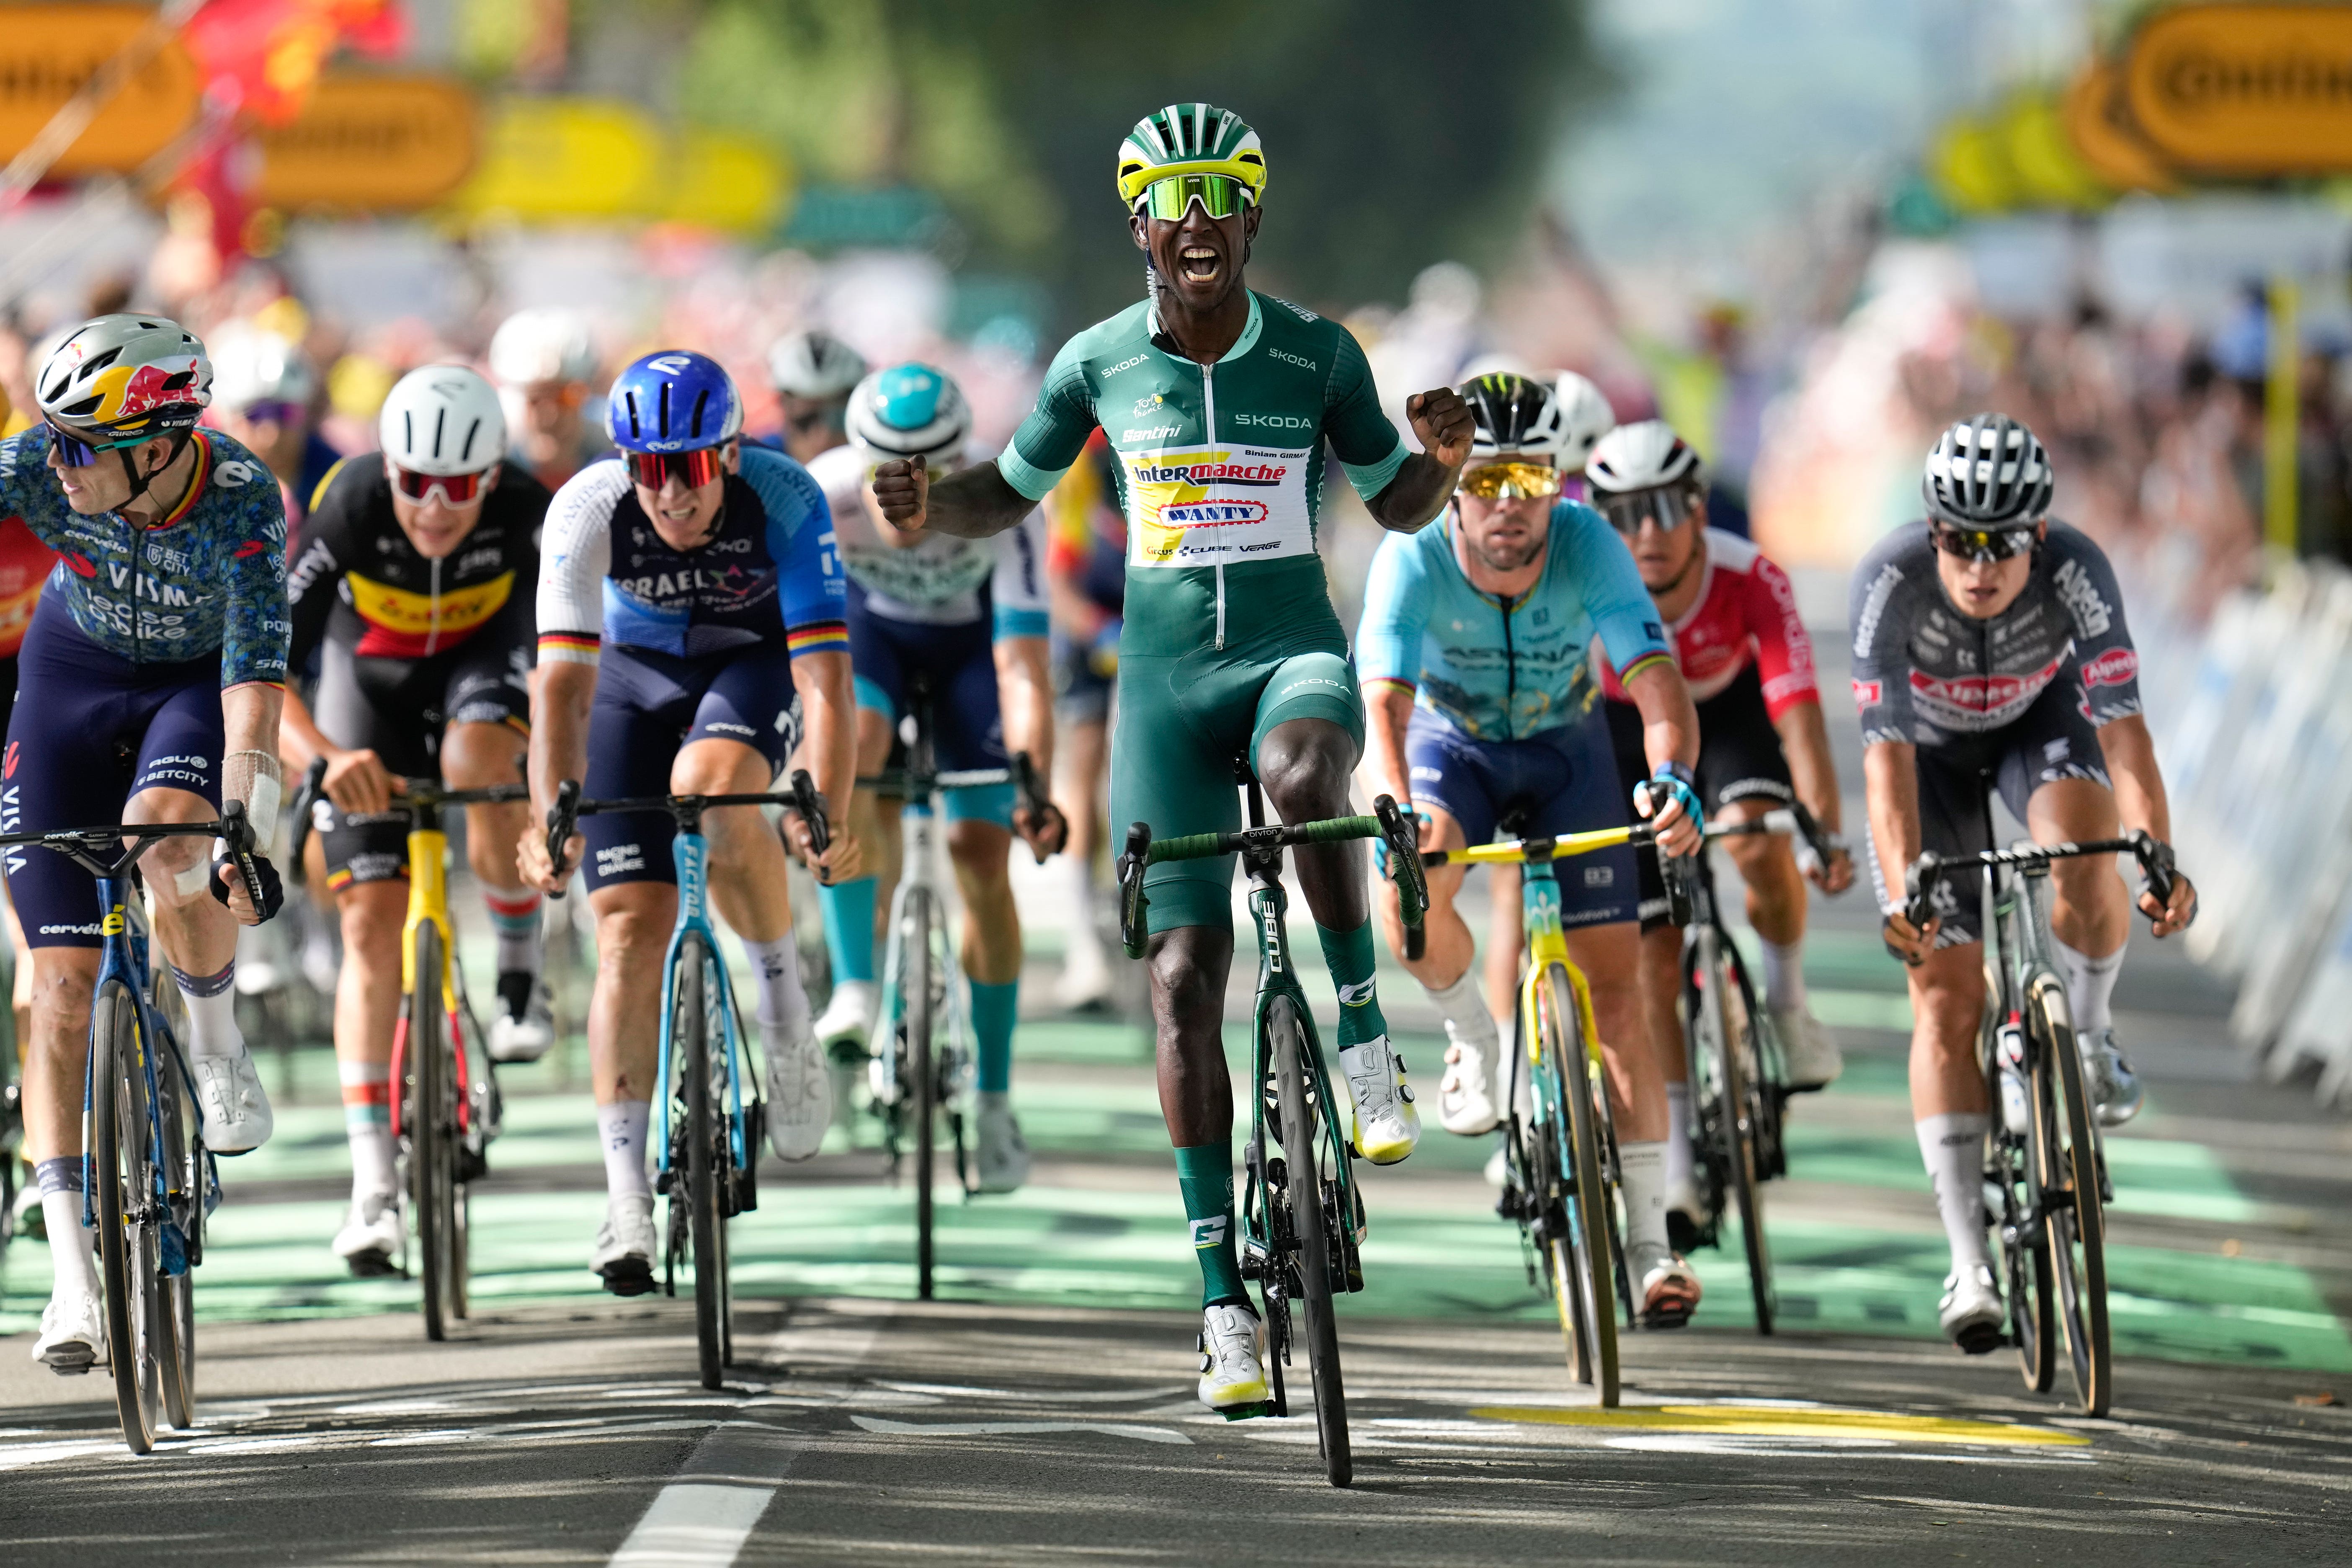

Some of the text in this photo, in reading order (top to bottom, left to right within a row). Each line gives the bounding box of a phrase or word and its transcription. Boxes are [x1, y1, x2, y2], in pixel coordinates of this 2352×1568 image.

[1122, 425, 1182, 443] Santini
[1245, 450, 1277, 458] Biniam
[1168, 507, 1254, 521] WANTY
[1147, 546, 1173, 555] Circus
[1239, 541, 1282, 552] VERGE
[165, 548, 189, 564] BET
[163, 560, 191, 576] CITY
[149, 756, 191, 769] AGU
[146, 769, 209, 787] BETCITY
[683, 844, 701, 918] FACTOR
[1263, 901, 1282, 973] CUBE
